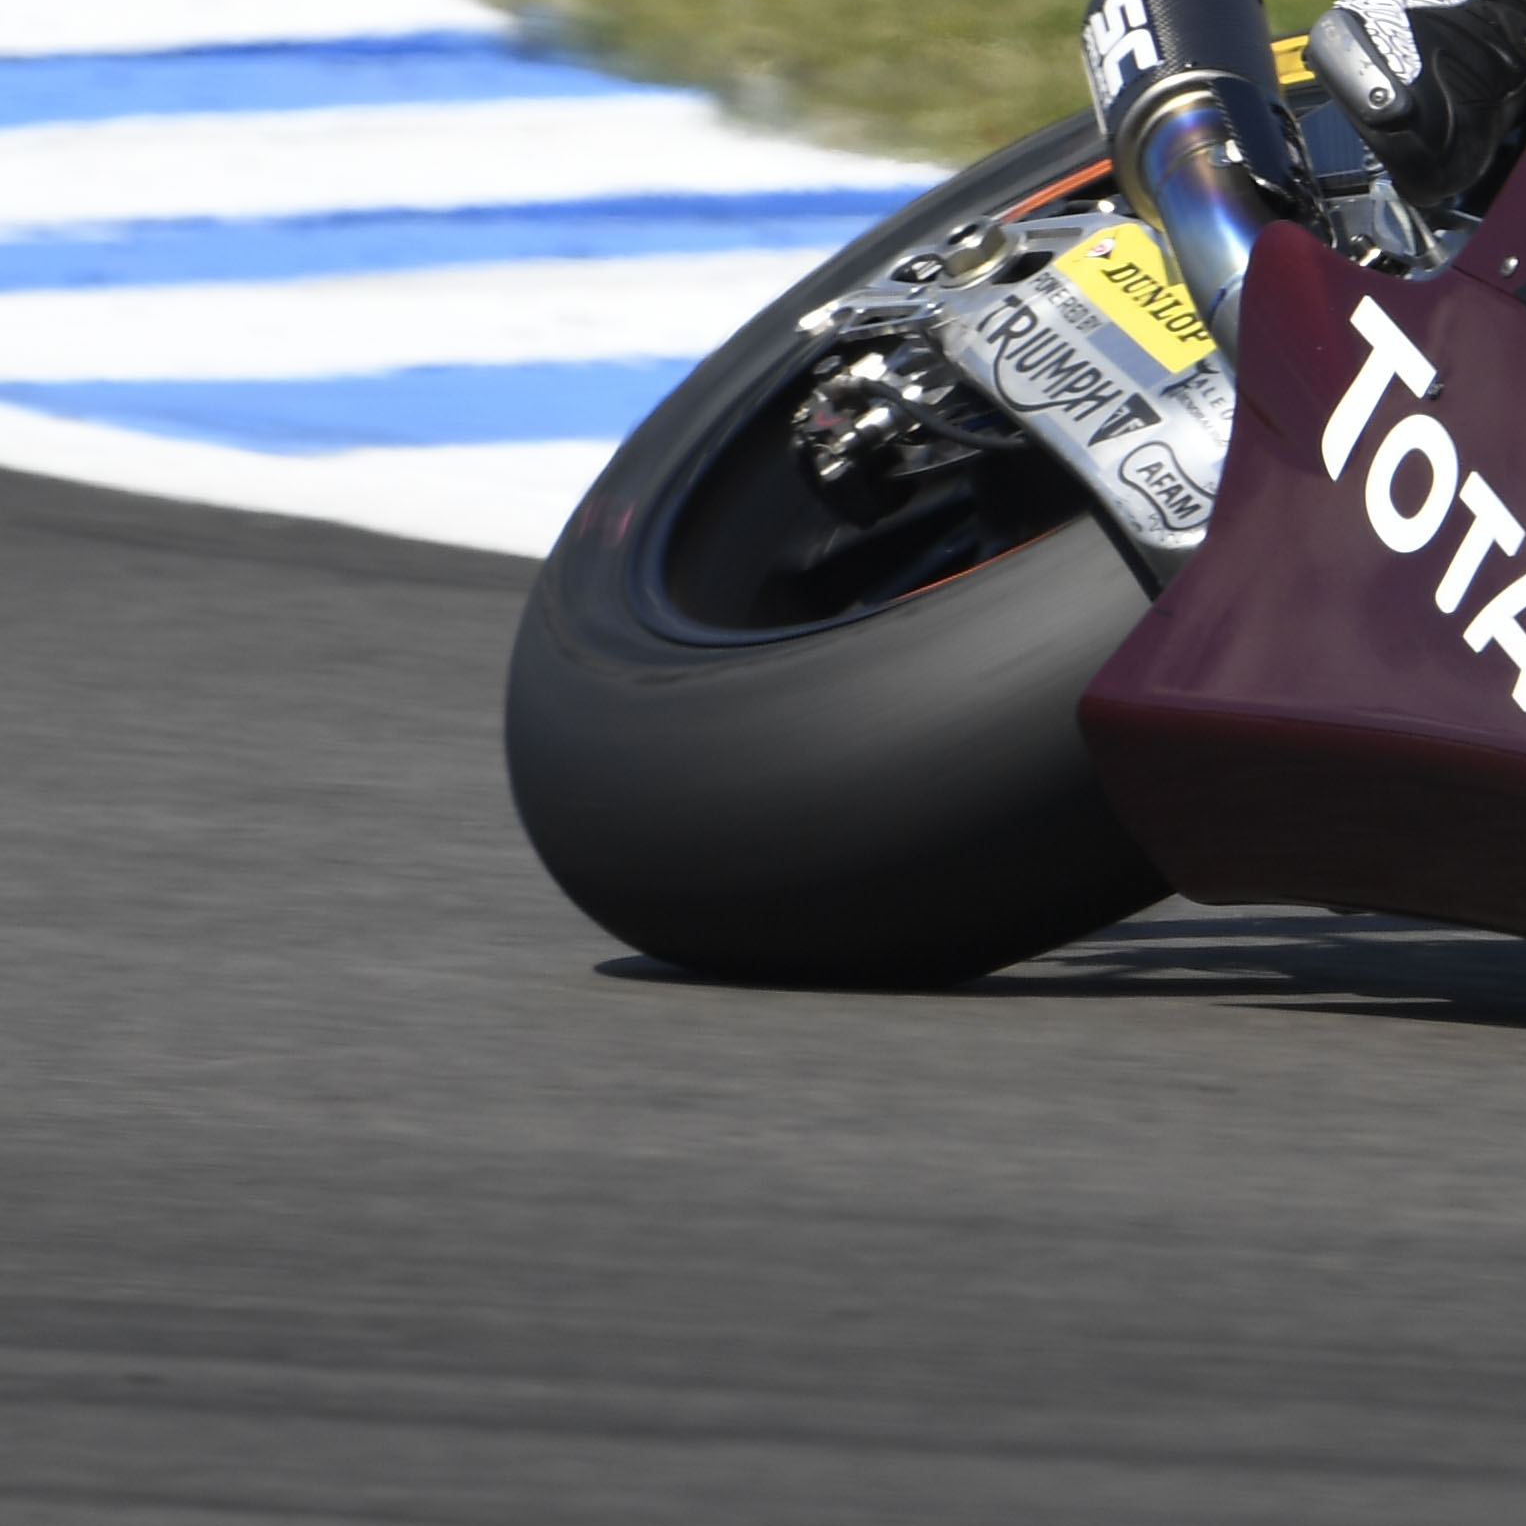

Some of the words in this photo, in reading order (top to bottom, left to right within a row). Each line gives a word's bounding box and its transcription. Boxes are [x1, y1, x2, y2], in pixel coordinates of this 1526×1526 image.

[1028, 270, 1088, 325] POWERED
[1101, 261, 1210, 344] DUNLOP
[977, 294, 1123, 422] TRIUMPH
[1136, 461, 1202, 520] AFAM
